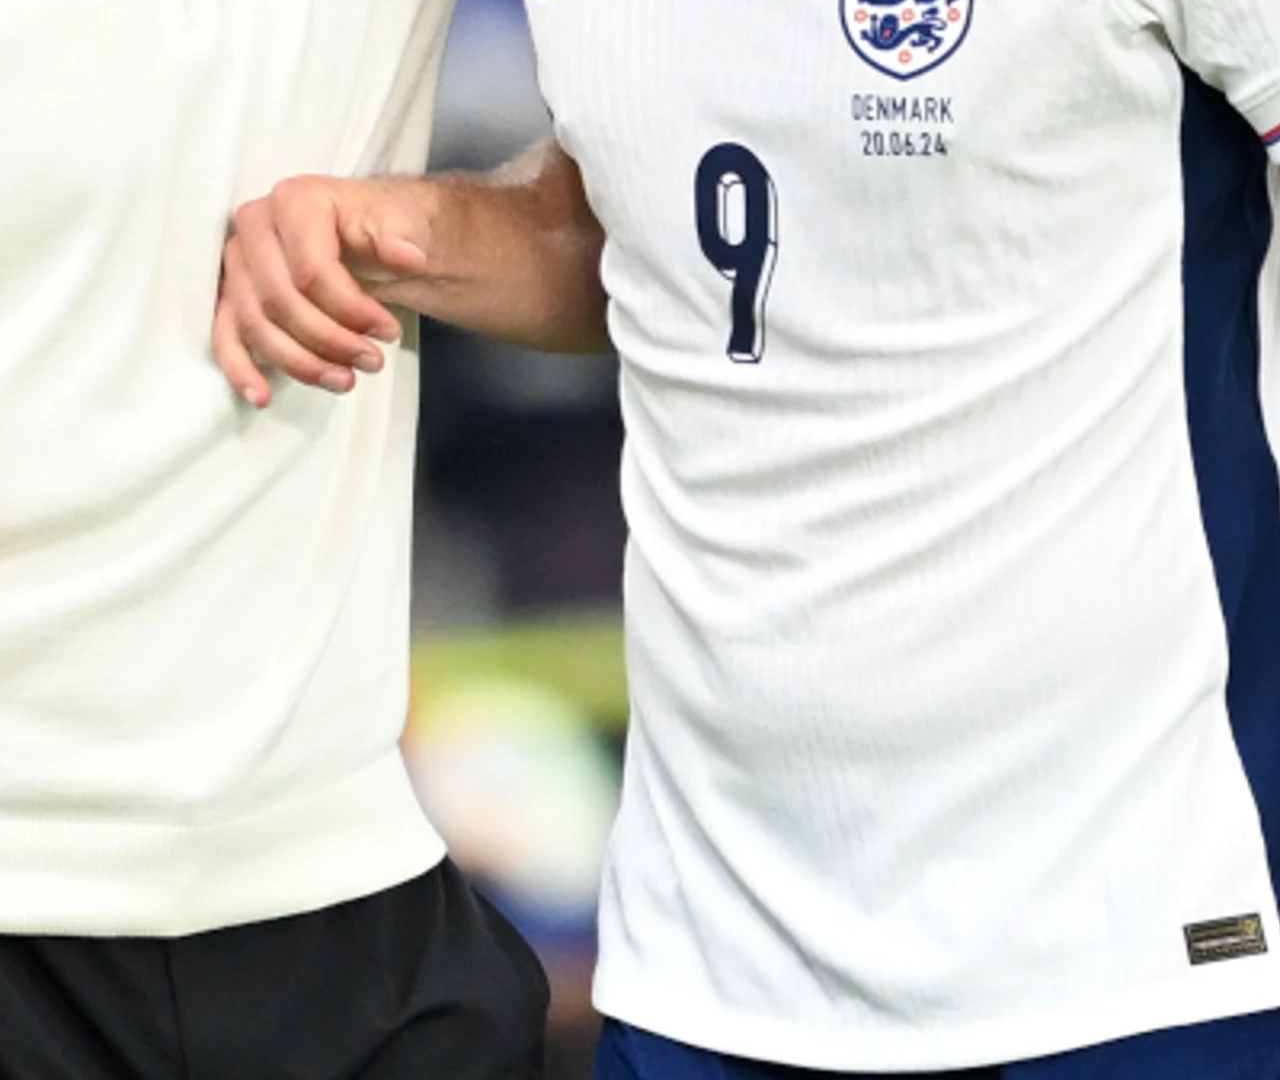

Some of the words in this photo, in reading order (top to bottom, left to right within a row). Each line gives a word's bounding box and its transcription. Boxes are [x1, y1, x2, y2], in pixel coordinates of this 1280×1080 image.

[852, 94, 955, 123] DENMARK
[861, 130, 949, 157] 20.06.24
[694, 142, 778, 364] 9
